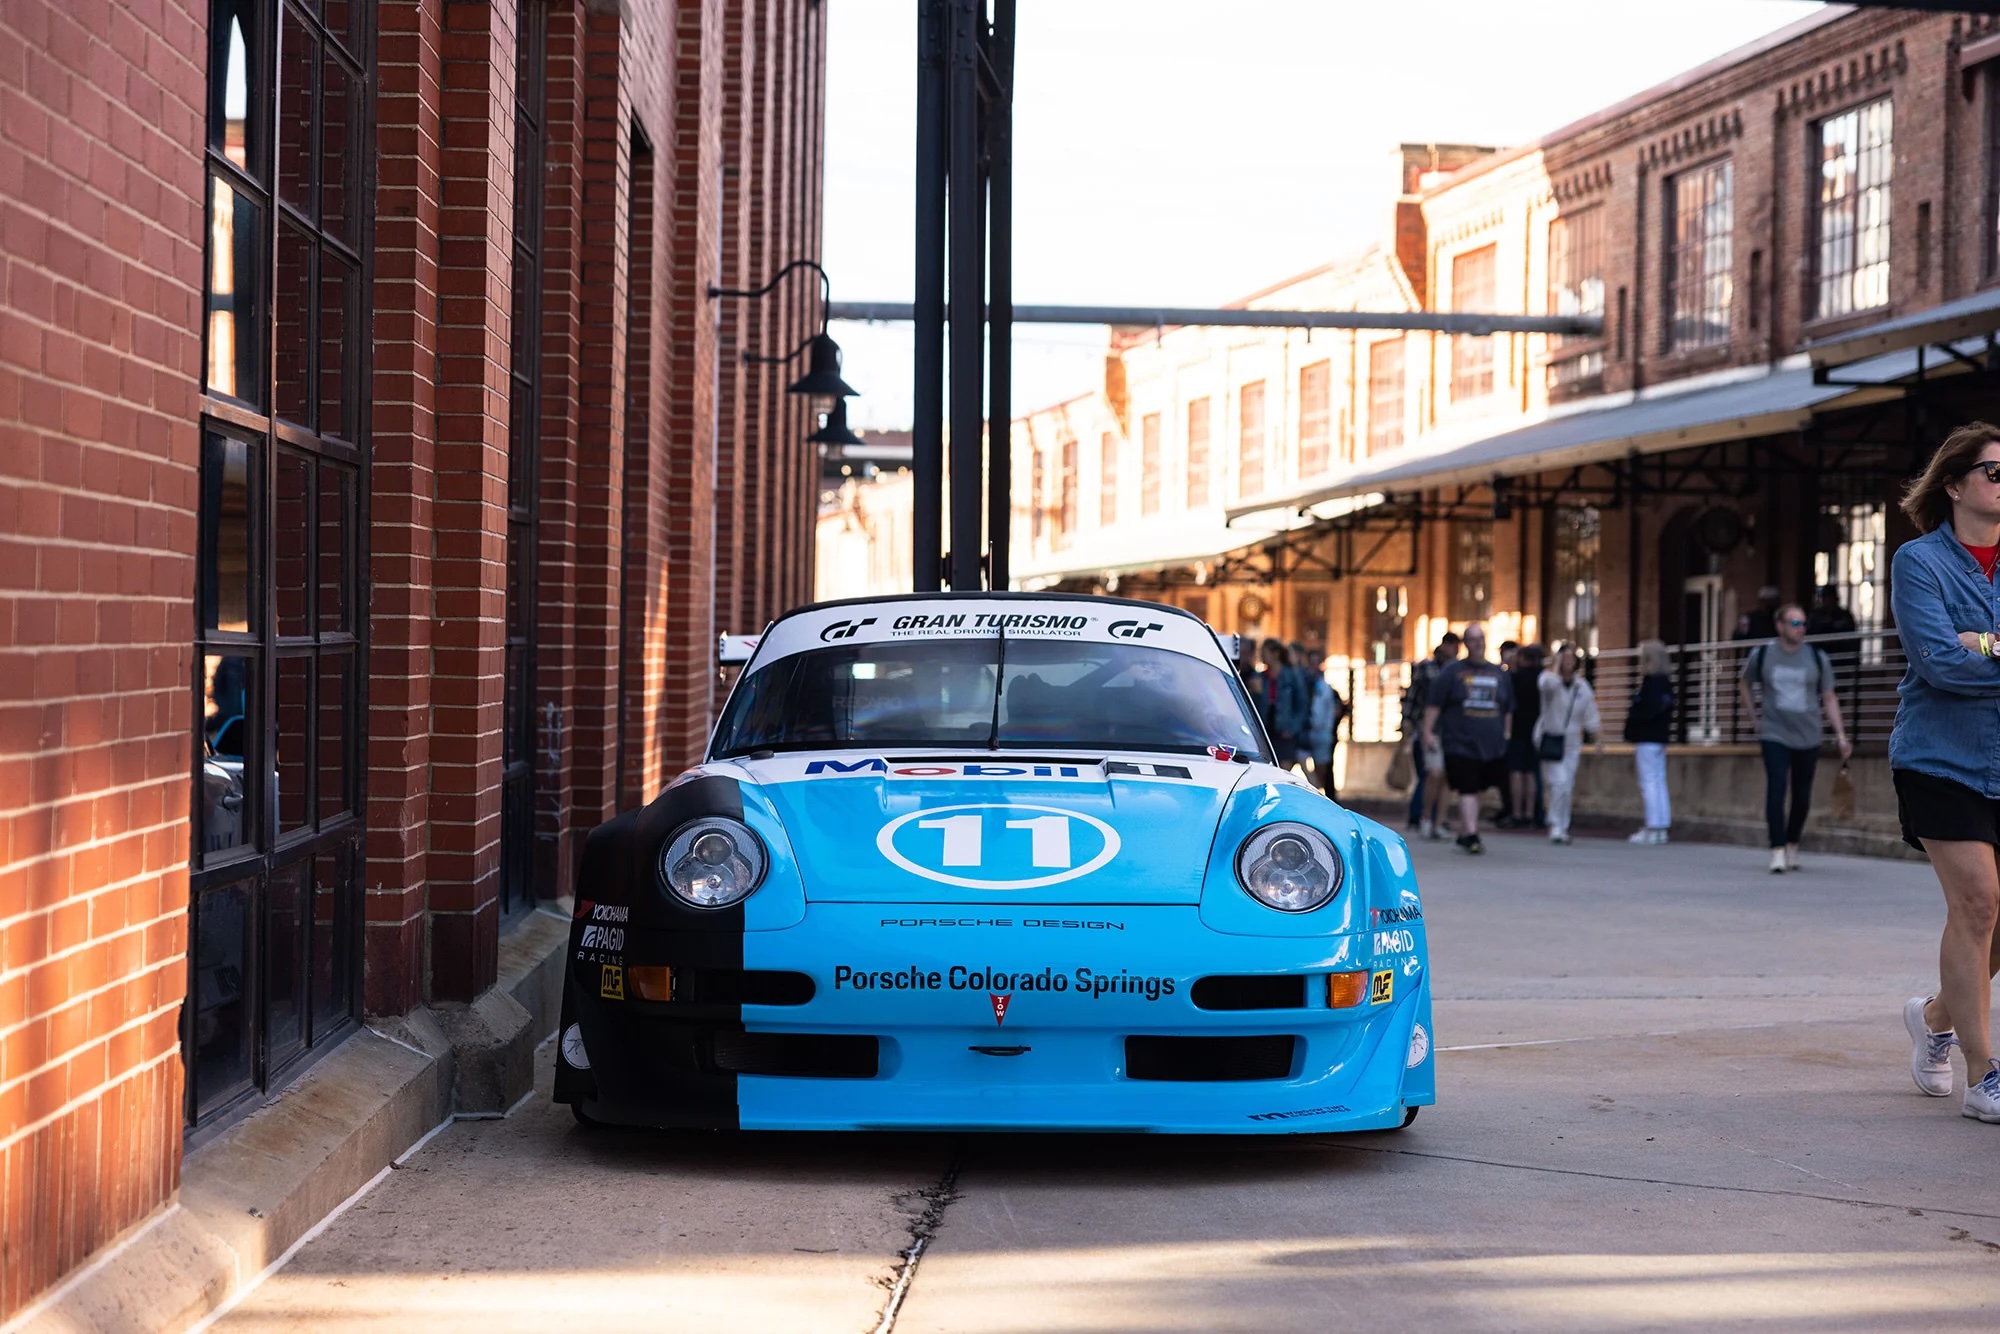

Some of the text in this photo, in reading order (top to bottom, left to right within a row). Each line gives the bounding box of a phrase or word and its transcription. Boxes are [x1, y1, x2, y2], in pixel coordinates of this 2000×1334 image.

[892, 614, 1088, 629] GRAN TURISMO
[805, 758, 1079, 777] Mobil
[918, 815, 1071, 868] 11
[592, 903, 629, 922] YOKOHAMA
[881, 918, 1125, 930] PORSCHE DESIGN
[595, 926, 625, 951] PAGID
[1381, 930, 1414, 954] PAGID
[577, 951, 623, 965] RACING
[835, 965, 1175, 1001] Porsche Colorado Springs
[996, 996, 1005, 1017] TOW
